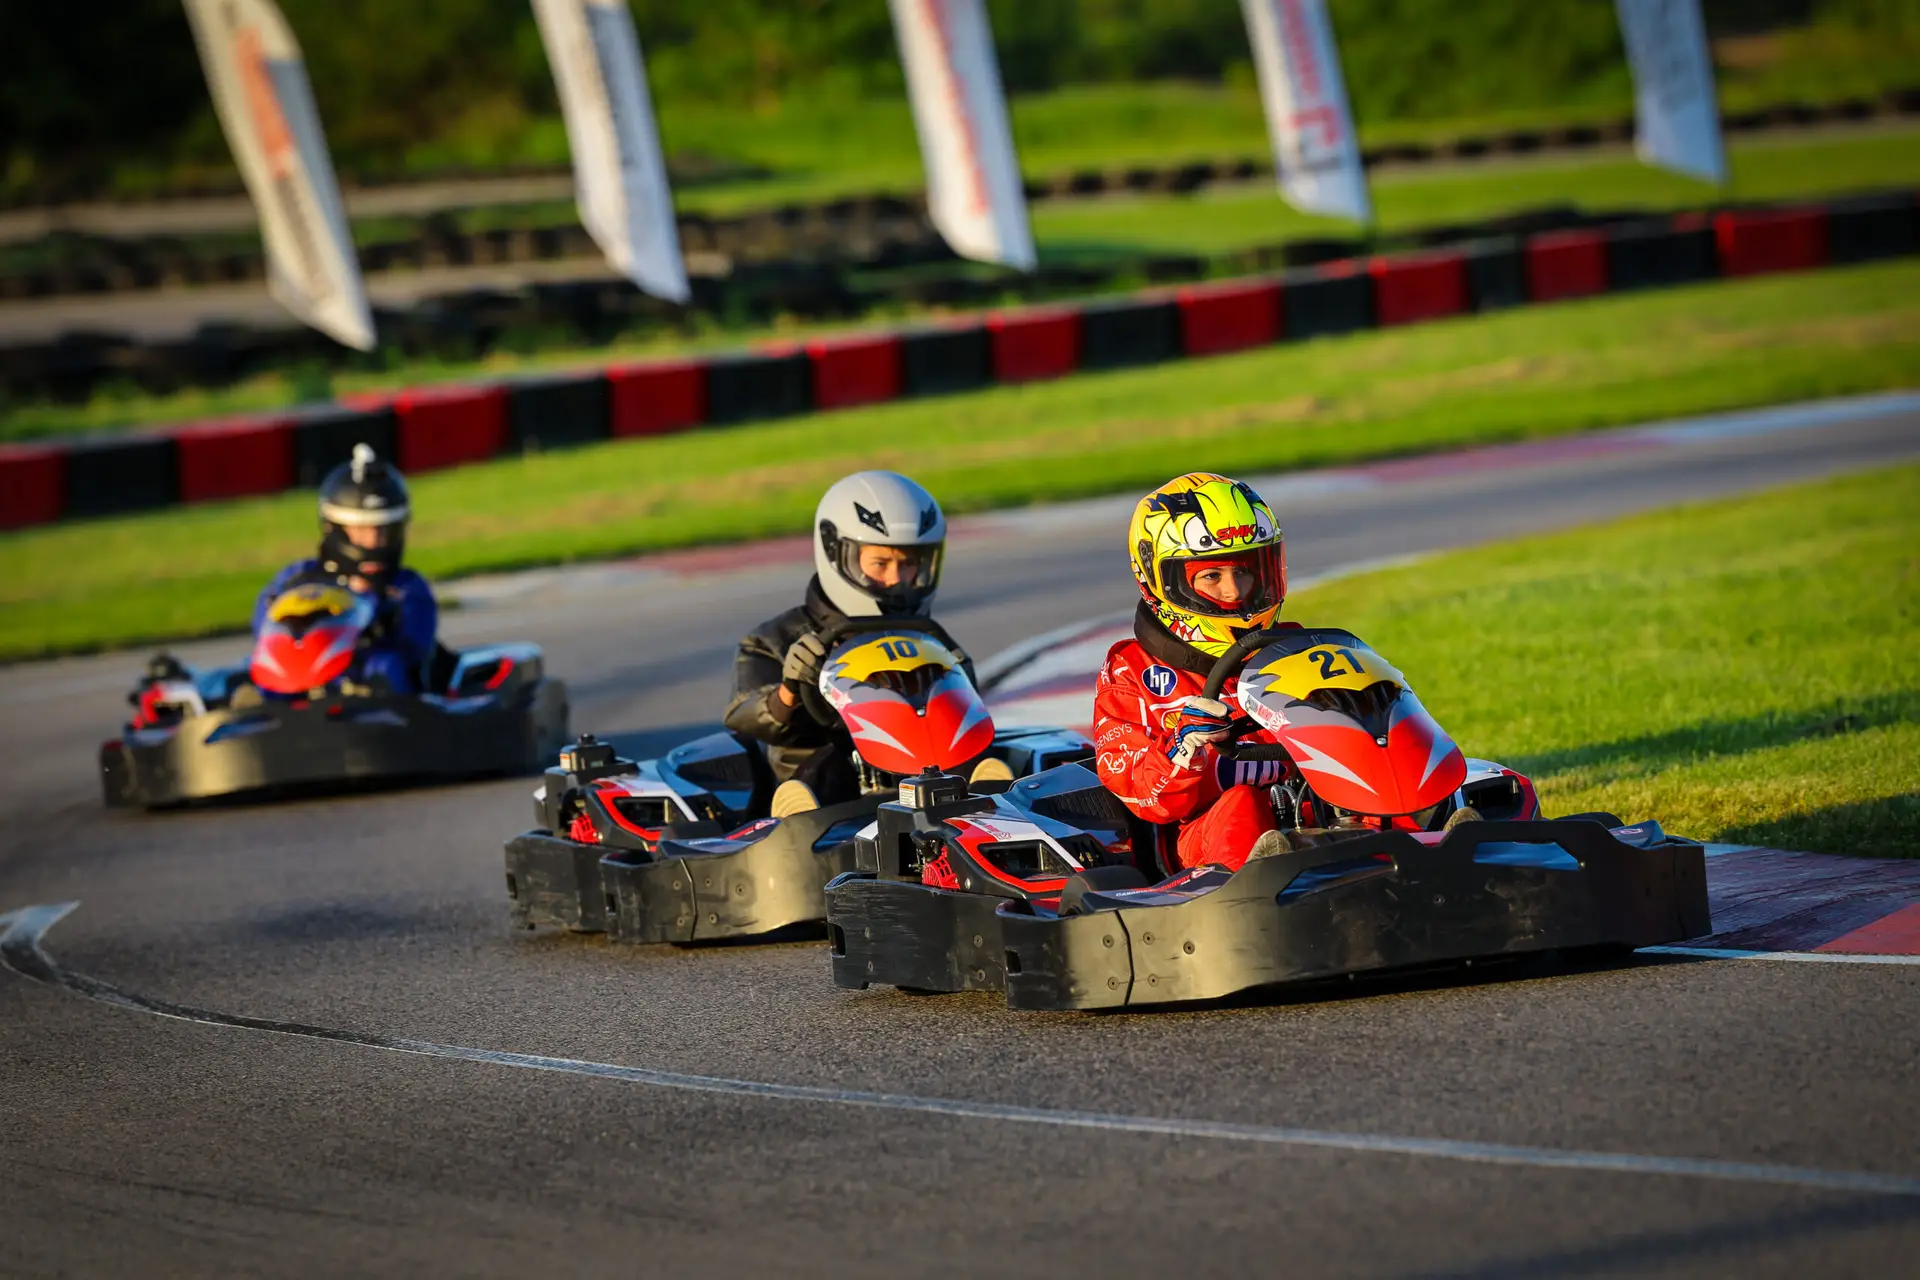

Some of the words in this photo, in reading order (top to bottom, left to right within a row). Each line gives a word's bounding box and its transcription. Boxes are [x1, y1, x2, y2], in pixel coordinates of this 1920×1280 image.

[1216, 524, 1256, 542] SMK
[876, 641, 919, 661] 10
[1308, 649, 1366, 681] 21
[1150, 665, 1170, 696] hp
